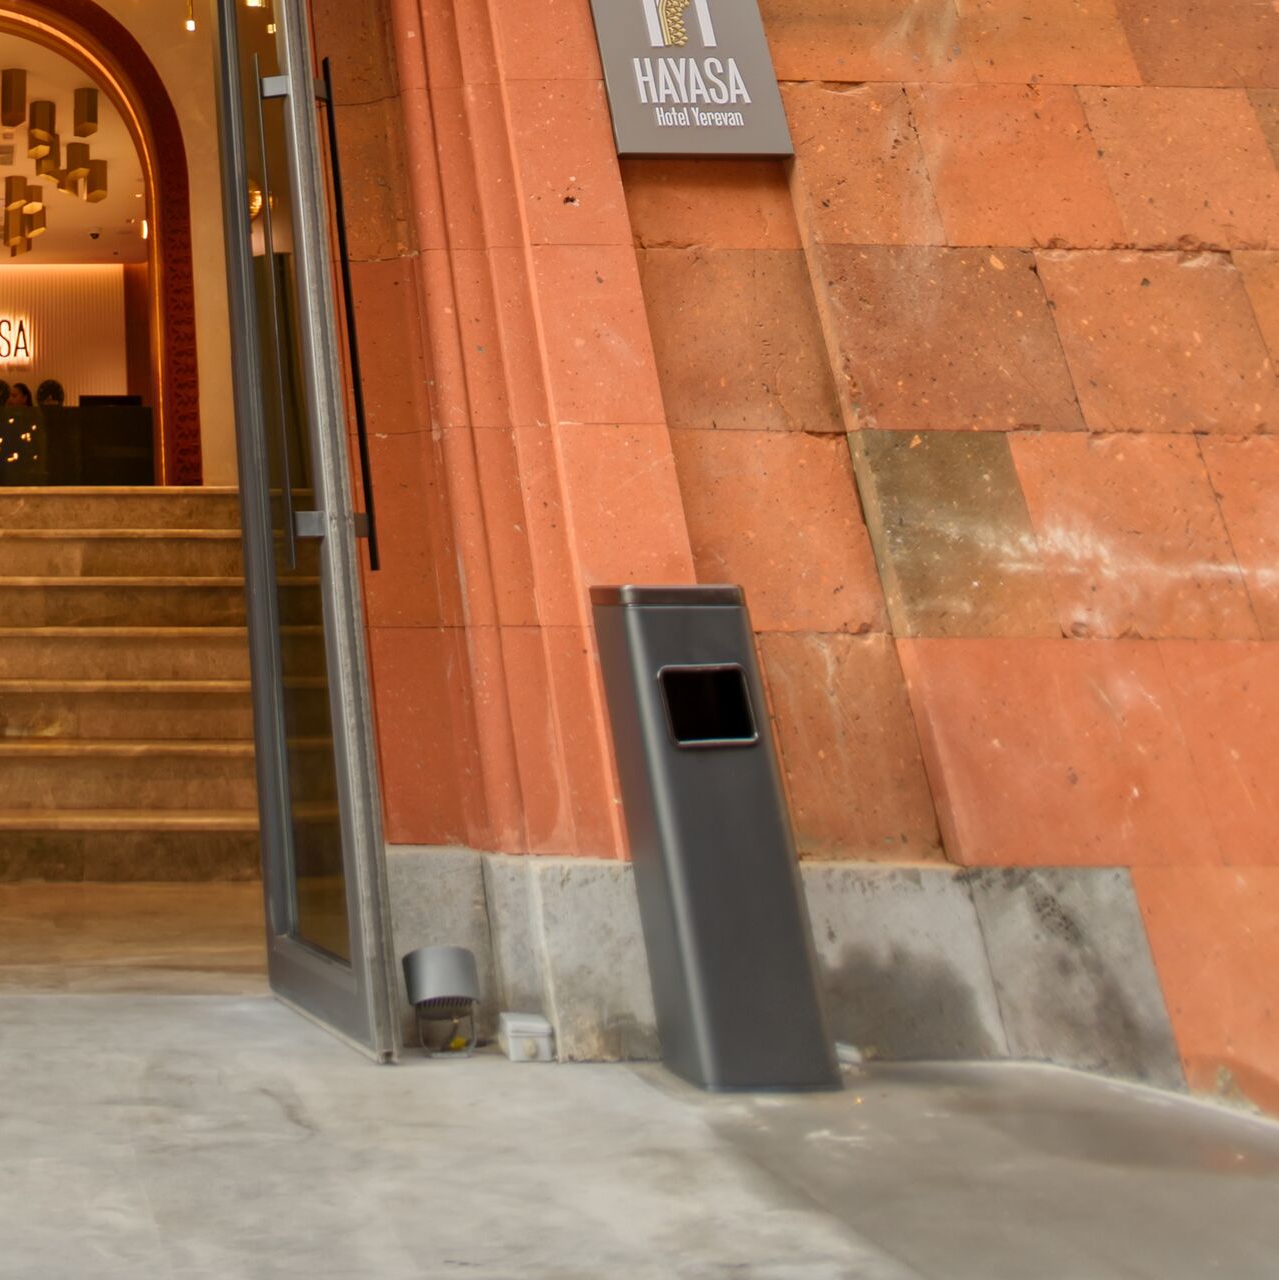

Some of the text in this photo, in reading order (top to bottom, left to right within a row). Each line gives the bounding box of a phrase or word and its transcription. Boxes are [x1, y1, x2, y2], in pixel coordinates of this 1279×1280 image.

[633, 57, 753, 105] HAYASA
[655, 107, 745, 127] Hotel Yerevan
